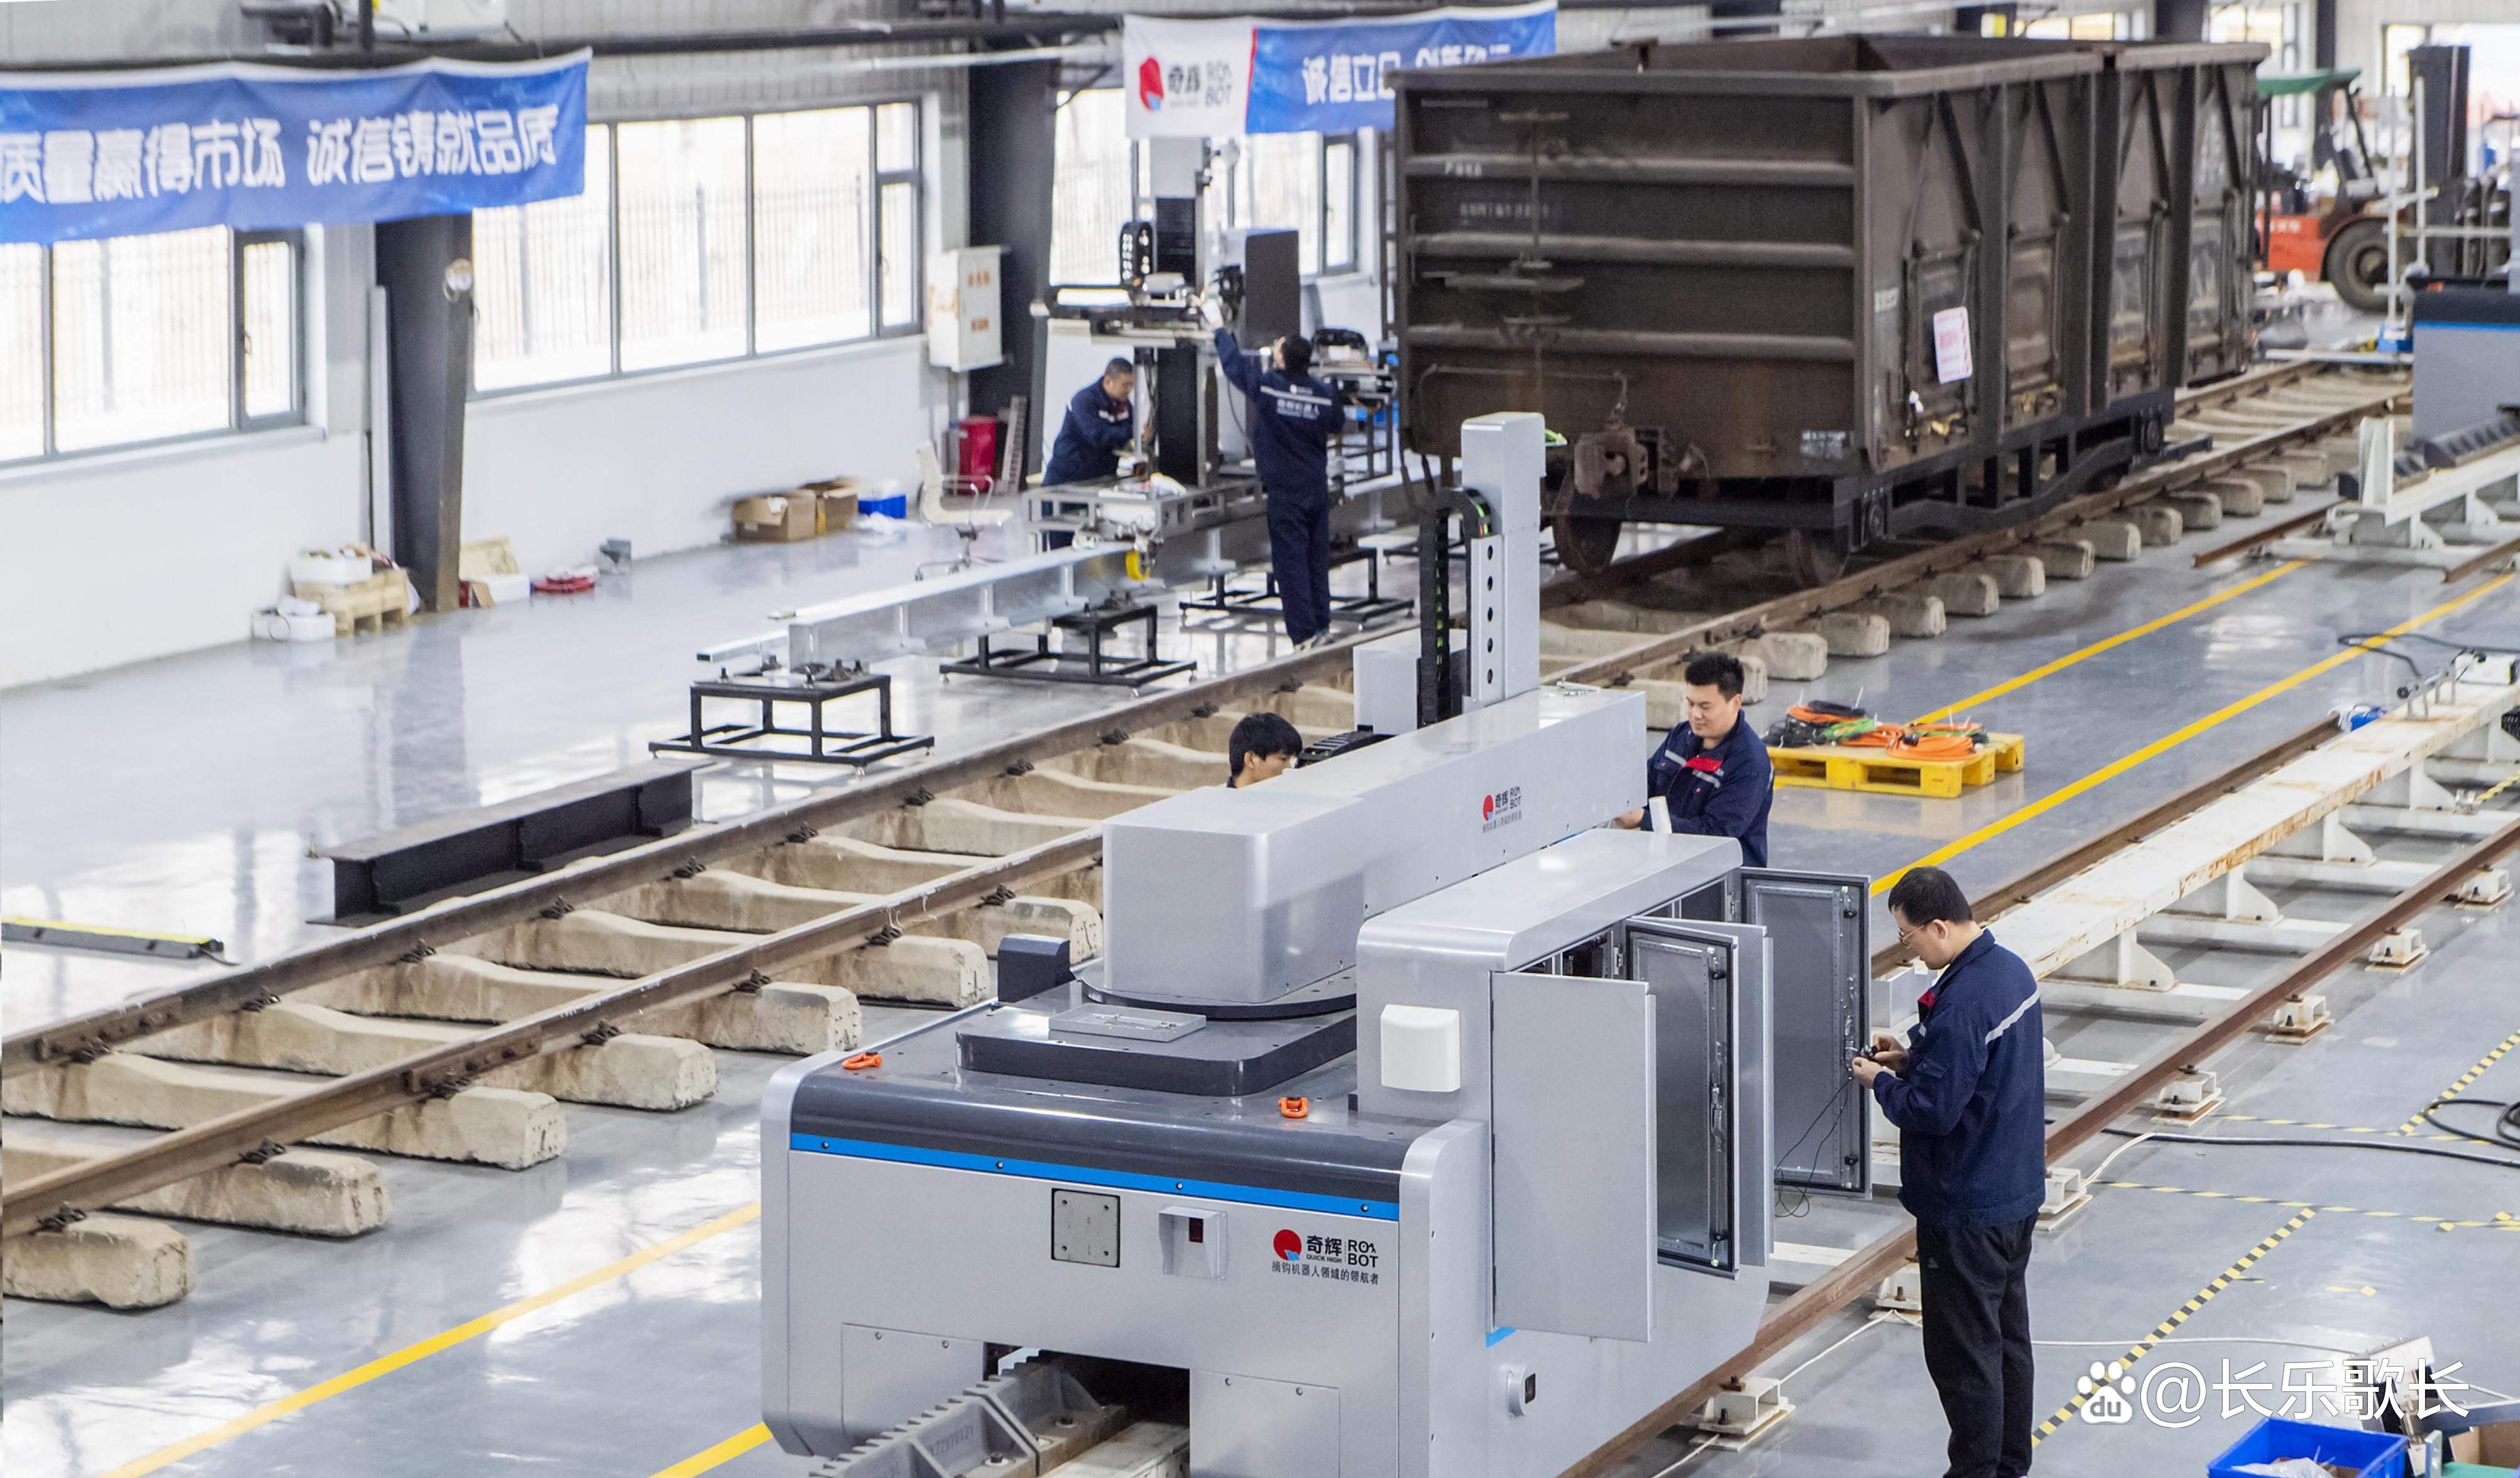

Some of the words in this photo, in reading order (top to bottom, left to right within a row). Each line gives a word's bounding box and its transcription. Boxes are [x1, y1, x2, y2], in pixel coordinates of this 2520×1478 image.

[0, 118, 286, 204] 质量赢得市场
[307, 103, 559, 186] 诚信铸就品质
[1306, 1235, 1342, 1257] 奇辉
[1306, 1254, 1326, 1262] QUICK
[1348, 1253, 1379, 1268] BOT
[1272, 1261, 1379, 1285] 摘钩机器人领域的领航者
